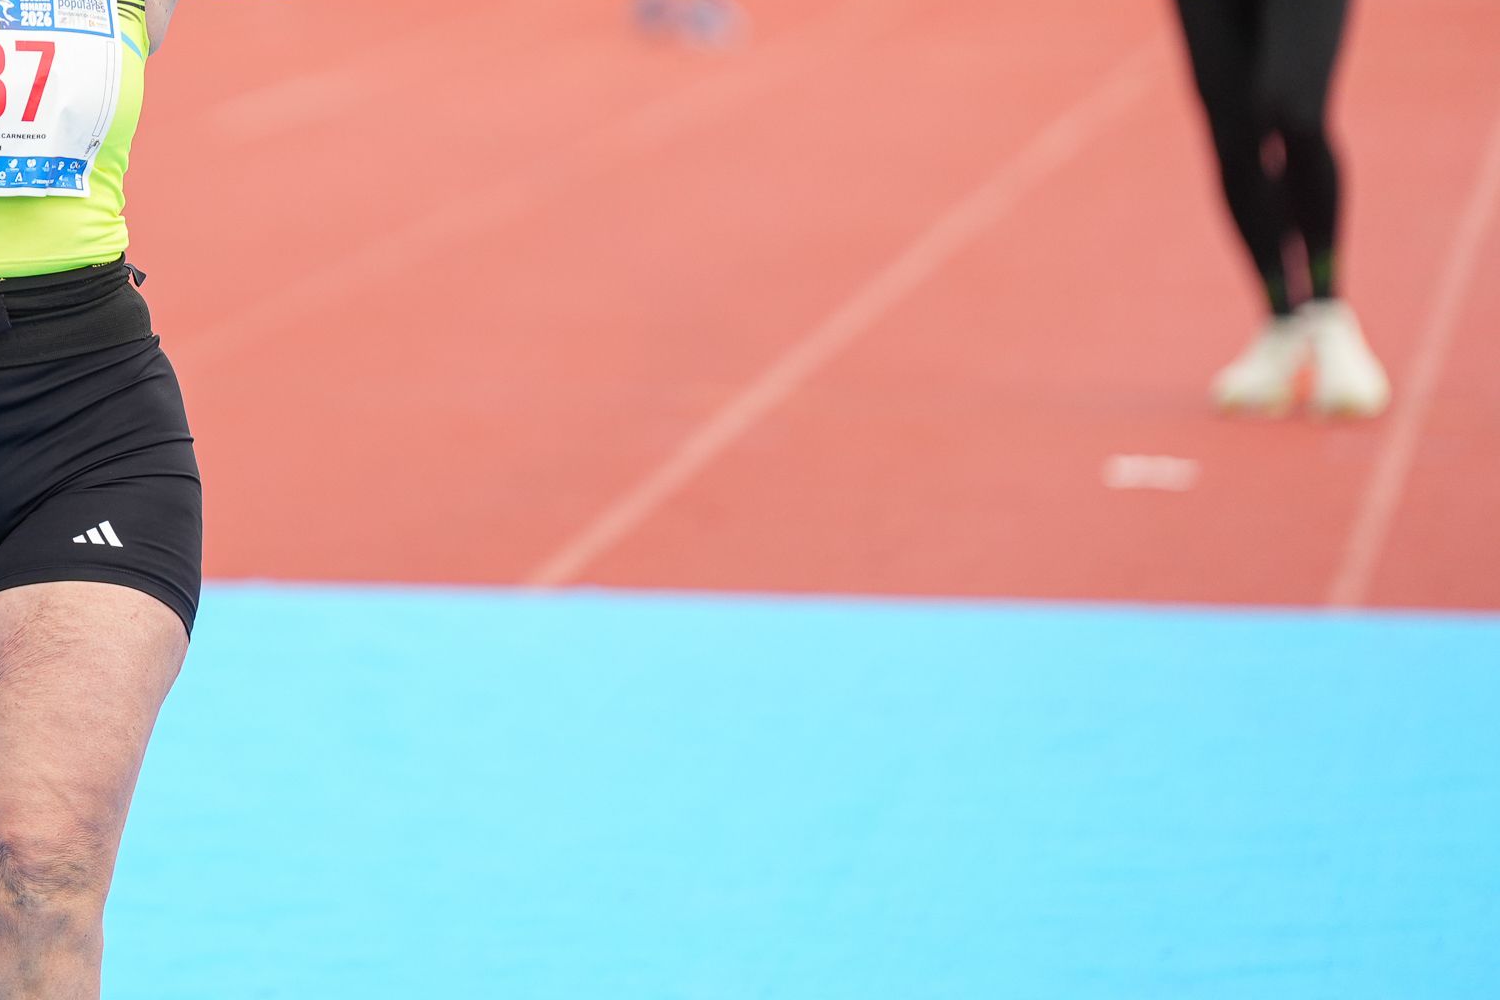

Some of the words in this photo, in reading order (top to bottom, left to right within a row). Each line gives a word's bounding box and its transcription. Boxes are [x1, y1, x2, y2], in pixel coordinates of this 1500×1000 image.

[57, 0, 106, 14] populares
[20, 11, 52, 27] 2026
[1, 132, 47, 140] CARNERERO
